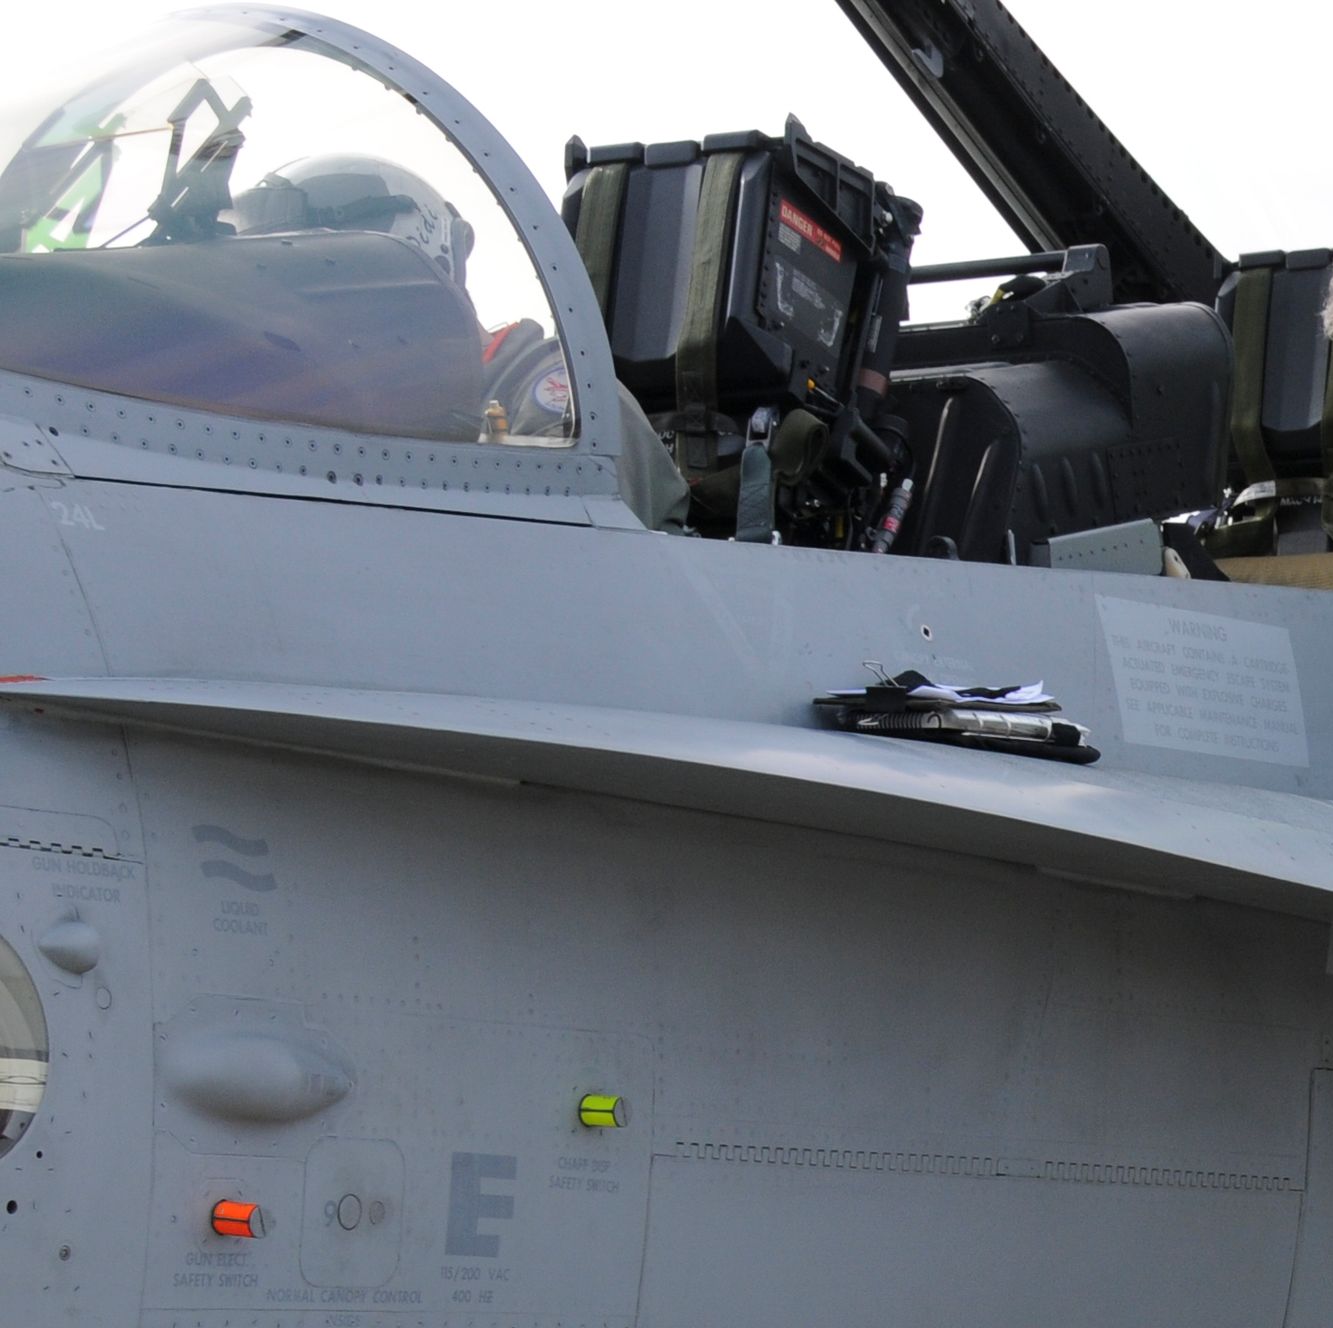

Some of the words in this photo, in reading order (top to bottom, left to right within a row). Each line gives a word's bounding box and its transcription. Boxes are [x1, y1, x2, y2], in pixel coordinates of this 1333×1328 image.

[783, 206, 813, 236] DANGER
[50, 501, 106, 531] 24L
[1168, 617, 1228, 642] WARNING
[1137, 640, 1176, 656] AIRCRAFT
[1182, 646, 1226, 664] CONTAINS
[31, 856, 62, 872] GUN
[66, 859, 136, 880] HOLDBACK
[51, 883, 121, 902] INDICATOR
[220, 900, 260, 917] LIQUID
[212, 917, 268, 937] COOLANT
[549, 1175, 583, 1190] SAFETY
[586, 1178, 619, 1194] SWITCH
[445, 1152, 517, 1258] E
[186, 1252, 213, 1267] GUN
[173, 1272, 215, 1288] SAFETY
[218, 1273, 259, 1288] SWITCH
[488, 1267, 511, 1282] VAC
[266, 1288, 314, 1303] NORMAL
[319, 1289, 366, 1304] CANOPY
[372, 1290, 423, 1304] CONTROL
[452, 1289, 472, 1304] 400
